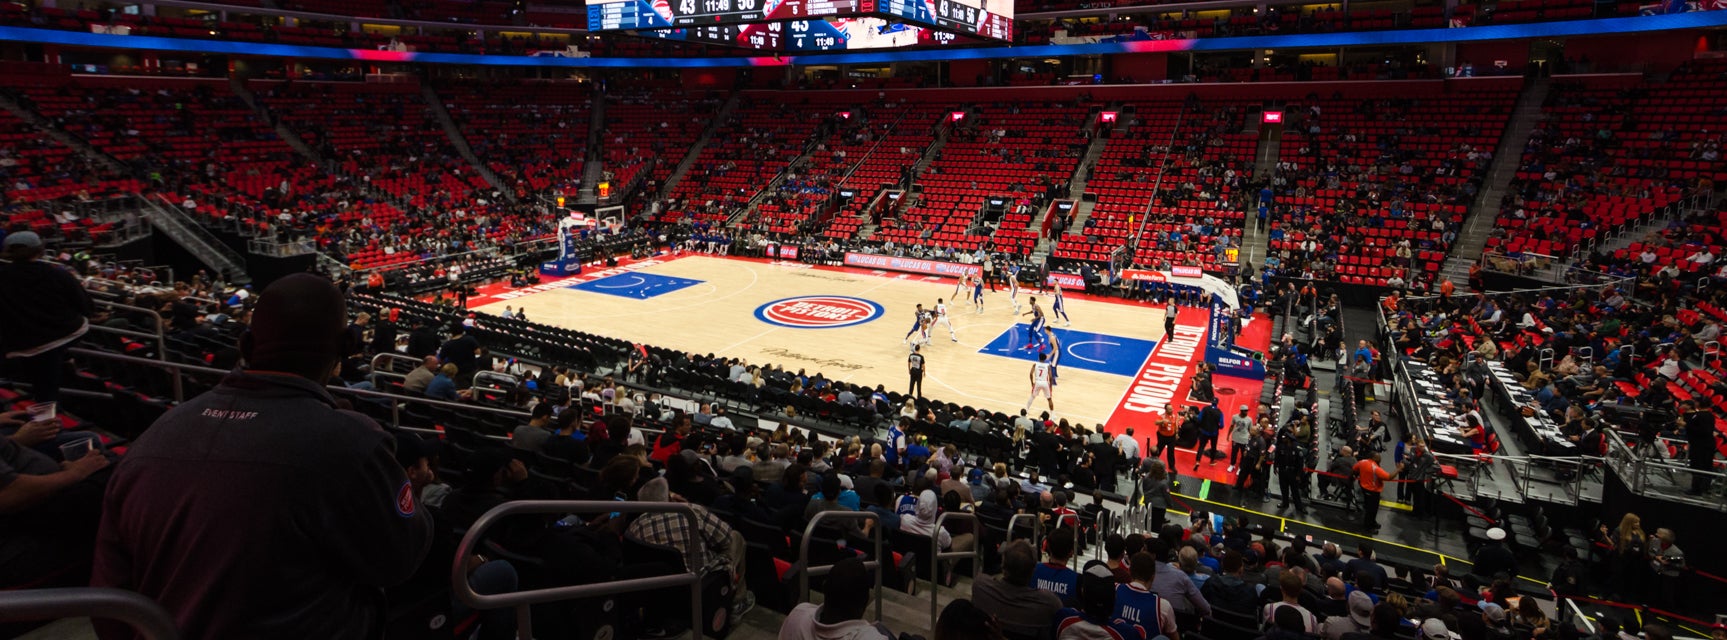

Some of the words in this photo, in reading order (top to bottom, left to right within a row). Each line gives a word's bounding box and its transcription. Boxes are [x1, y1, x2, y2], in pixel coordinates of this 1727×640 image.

[679, 0, 695, 15] 43
[705, 0, 729, 12] 11:49
[792, 5, 798, 15] 5
[939, 0, 949, 17] 43
[648, 16, 653, 25] 4
[952, 8, 964, 21] 11:49
[966, 7, 975, 24] 56
[750, 36, 764, 46] 11:49
[771, 38, 777, 47] 5
[797, 38, 803, 48] 4
[816, 37, 834, 47] 11:49
[857, 255, 877, 265] LUCAS
[876, 258, 886, 266] OIL
[900, 260, 921, 269] LUCAS
[920, 262, 931, 271] OIL
[1058, 277, 1075, 286] UCAS
[780, 305, 850, 321] PISTONS
[794, 301, 862, 315] DETROIT
[1157, 324, 1206, 362] DETROIT
[1218, 357, 1241, 365] BELFOR
[1039, 369, 1044, 378] 7
[1124, 362, 1188, 415] PISTONS
[201, 408, 229, 419] EVENT
[229, 410, 259, 420] STAFF
[1037, 578, 1068, 595] WALLACE
[1122, 604, 1141, 623] HILL
